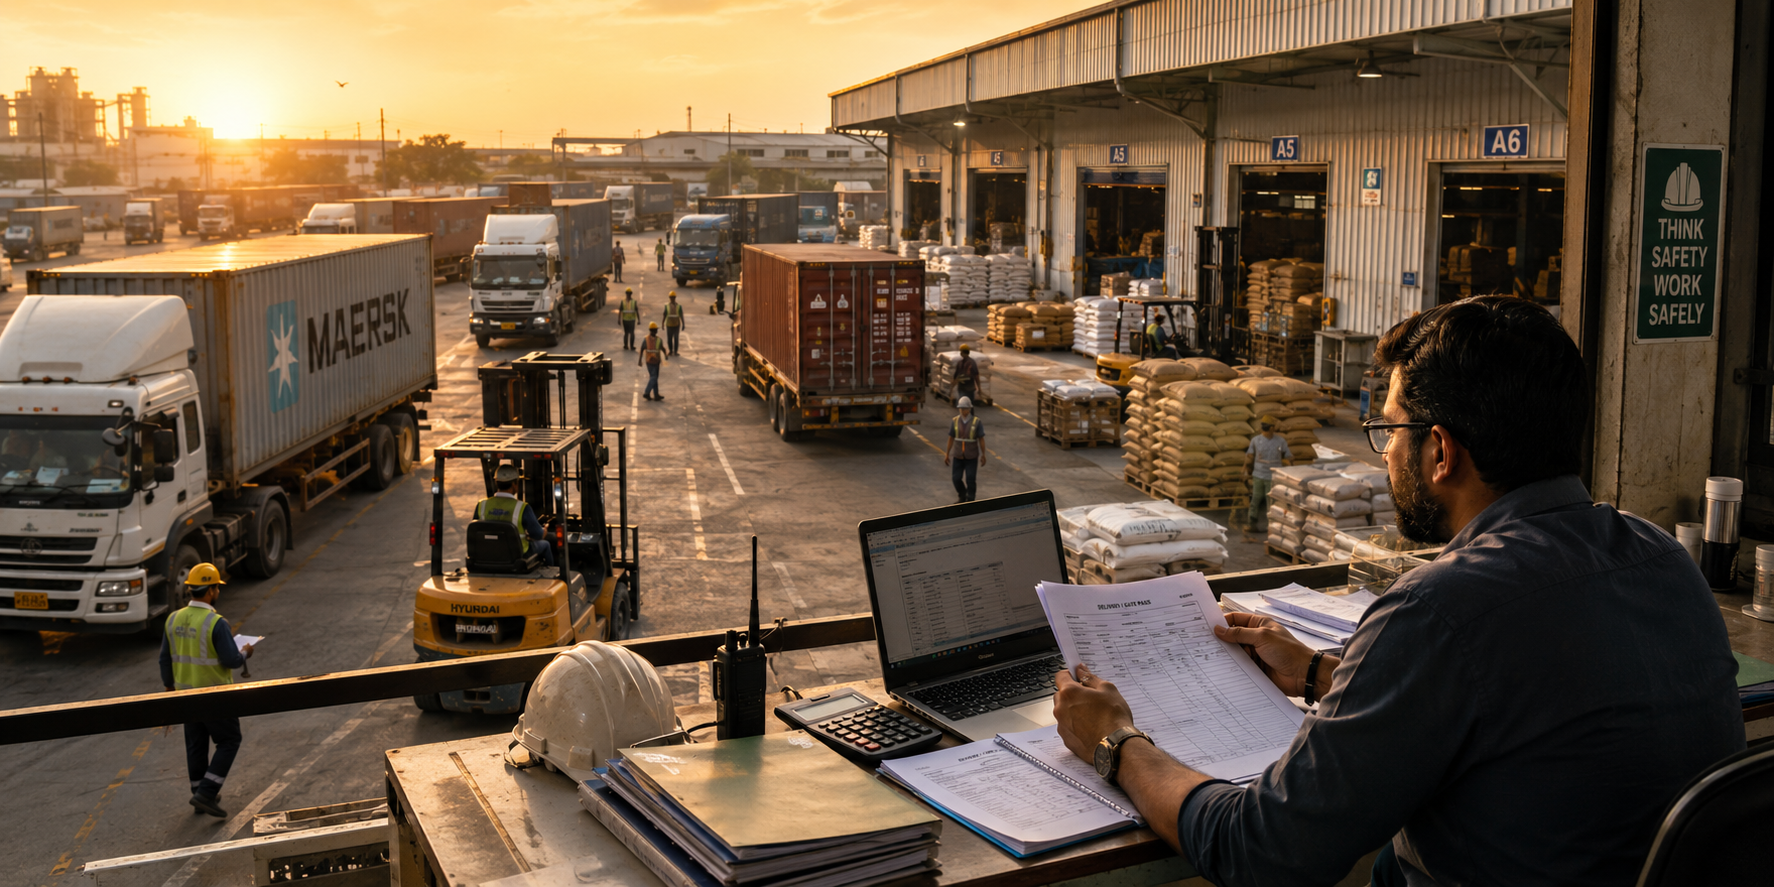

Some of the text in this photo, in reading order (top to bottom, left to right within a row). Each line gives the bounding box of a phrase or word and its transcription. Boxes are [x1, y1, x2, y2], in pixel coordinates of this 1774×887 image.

[1276, 139, 1295, 158] A5
[1491, 129, 1521, 154] A6
[1113, 147, 1125, 162] A5
[1658, 218, 1704, 240] THINK
[1651, 245, 1708, 268] SAFETY
[1654, 274, 1702, 296] WORK
[1648, 303, 1705, 326] SAFELY
[307, 288, 411, 374] MAERSK
